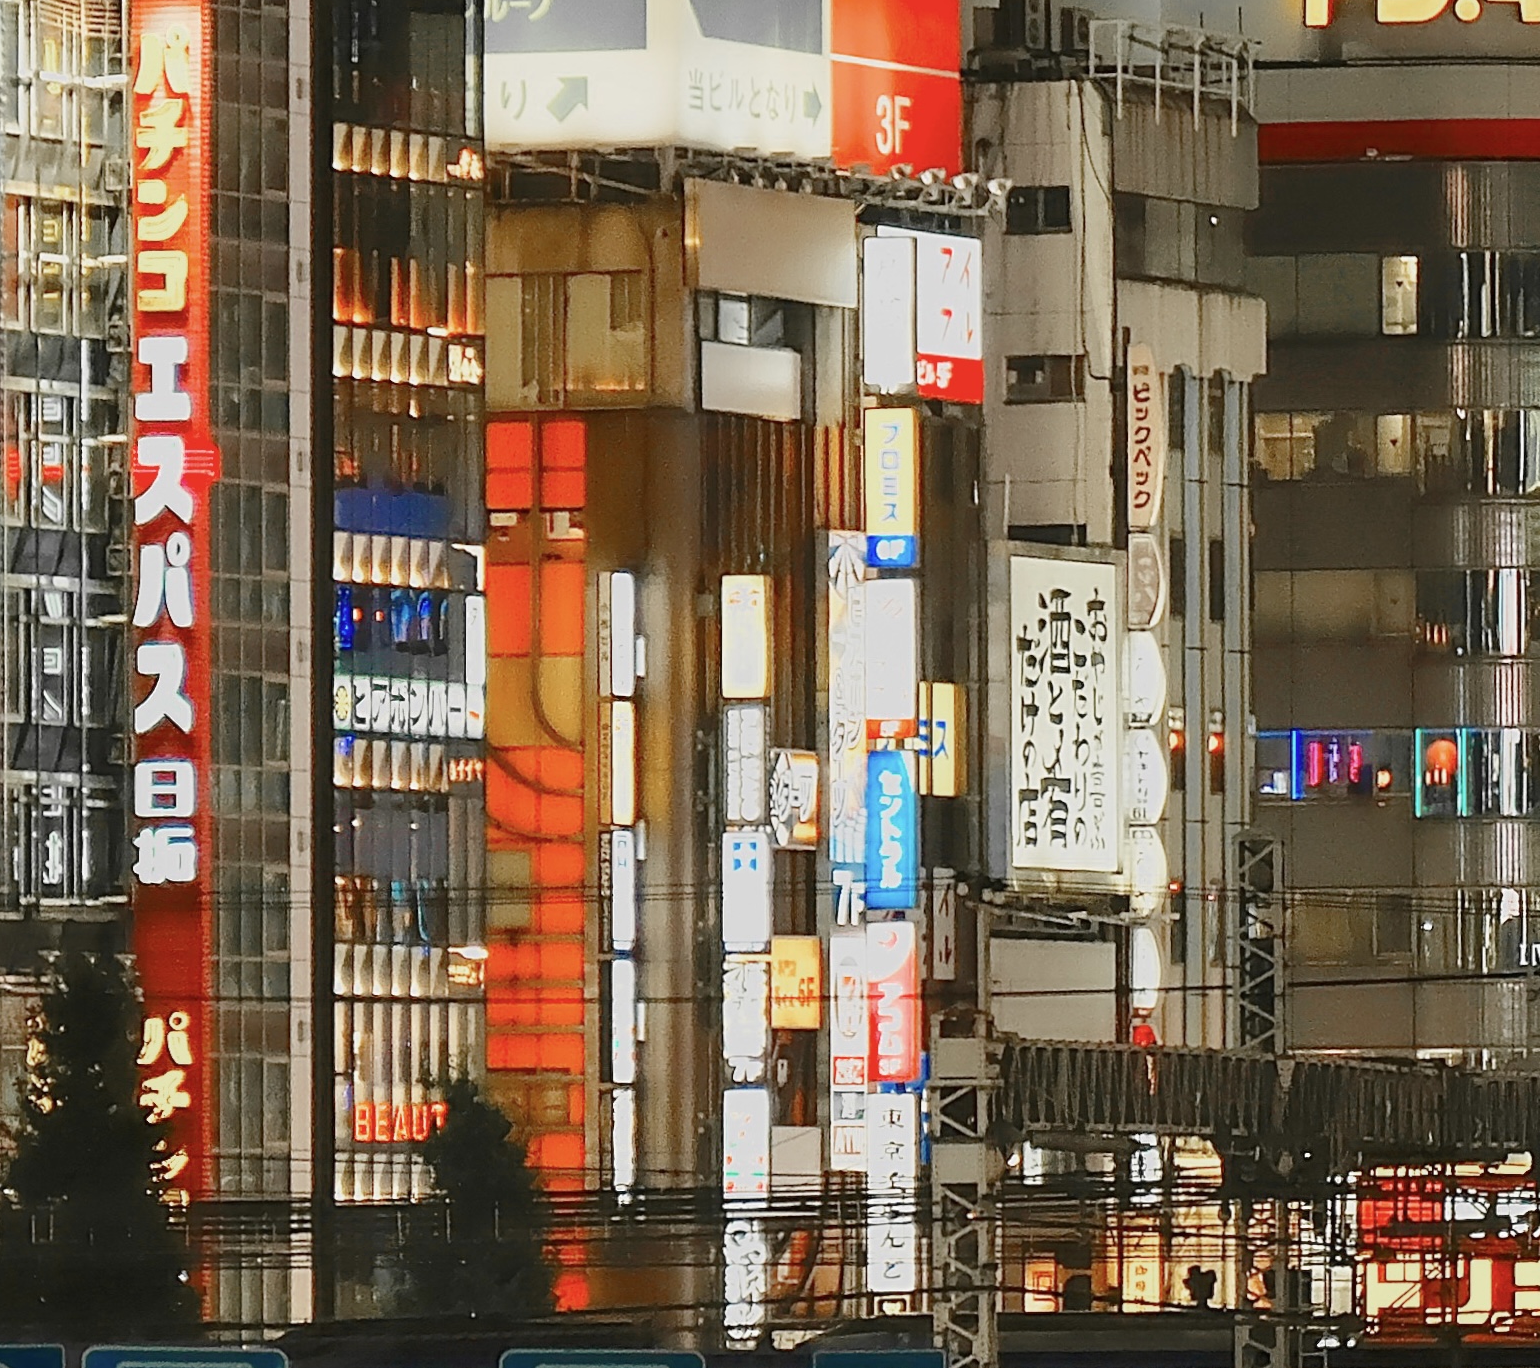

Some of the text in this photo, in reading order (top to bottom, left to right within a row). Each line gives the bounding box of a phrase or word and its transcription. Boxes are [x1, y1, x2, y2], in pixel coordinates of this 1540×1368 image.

[687, 67, 800, 126] 当ビルとなり
[875, 95, 913, 157] 3F
[134, 21, 196, 885] パチンコ エスパス 日拓
